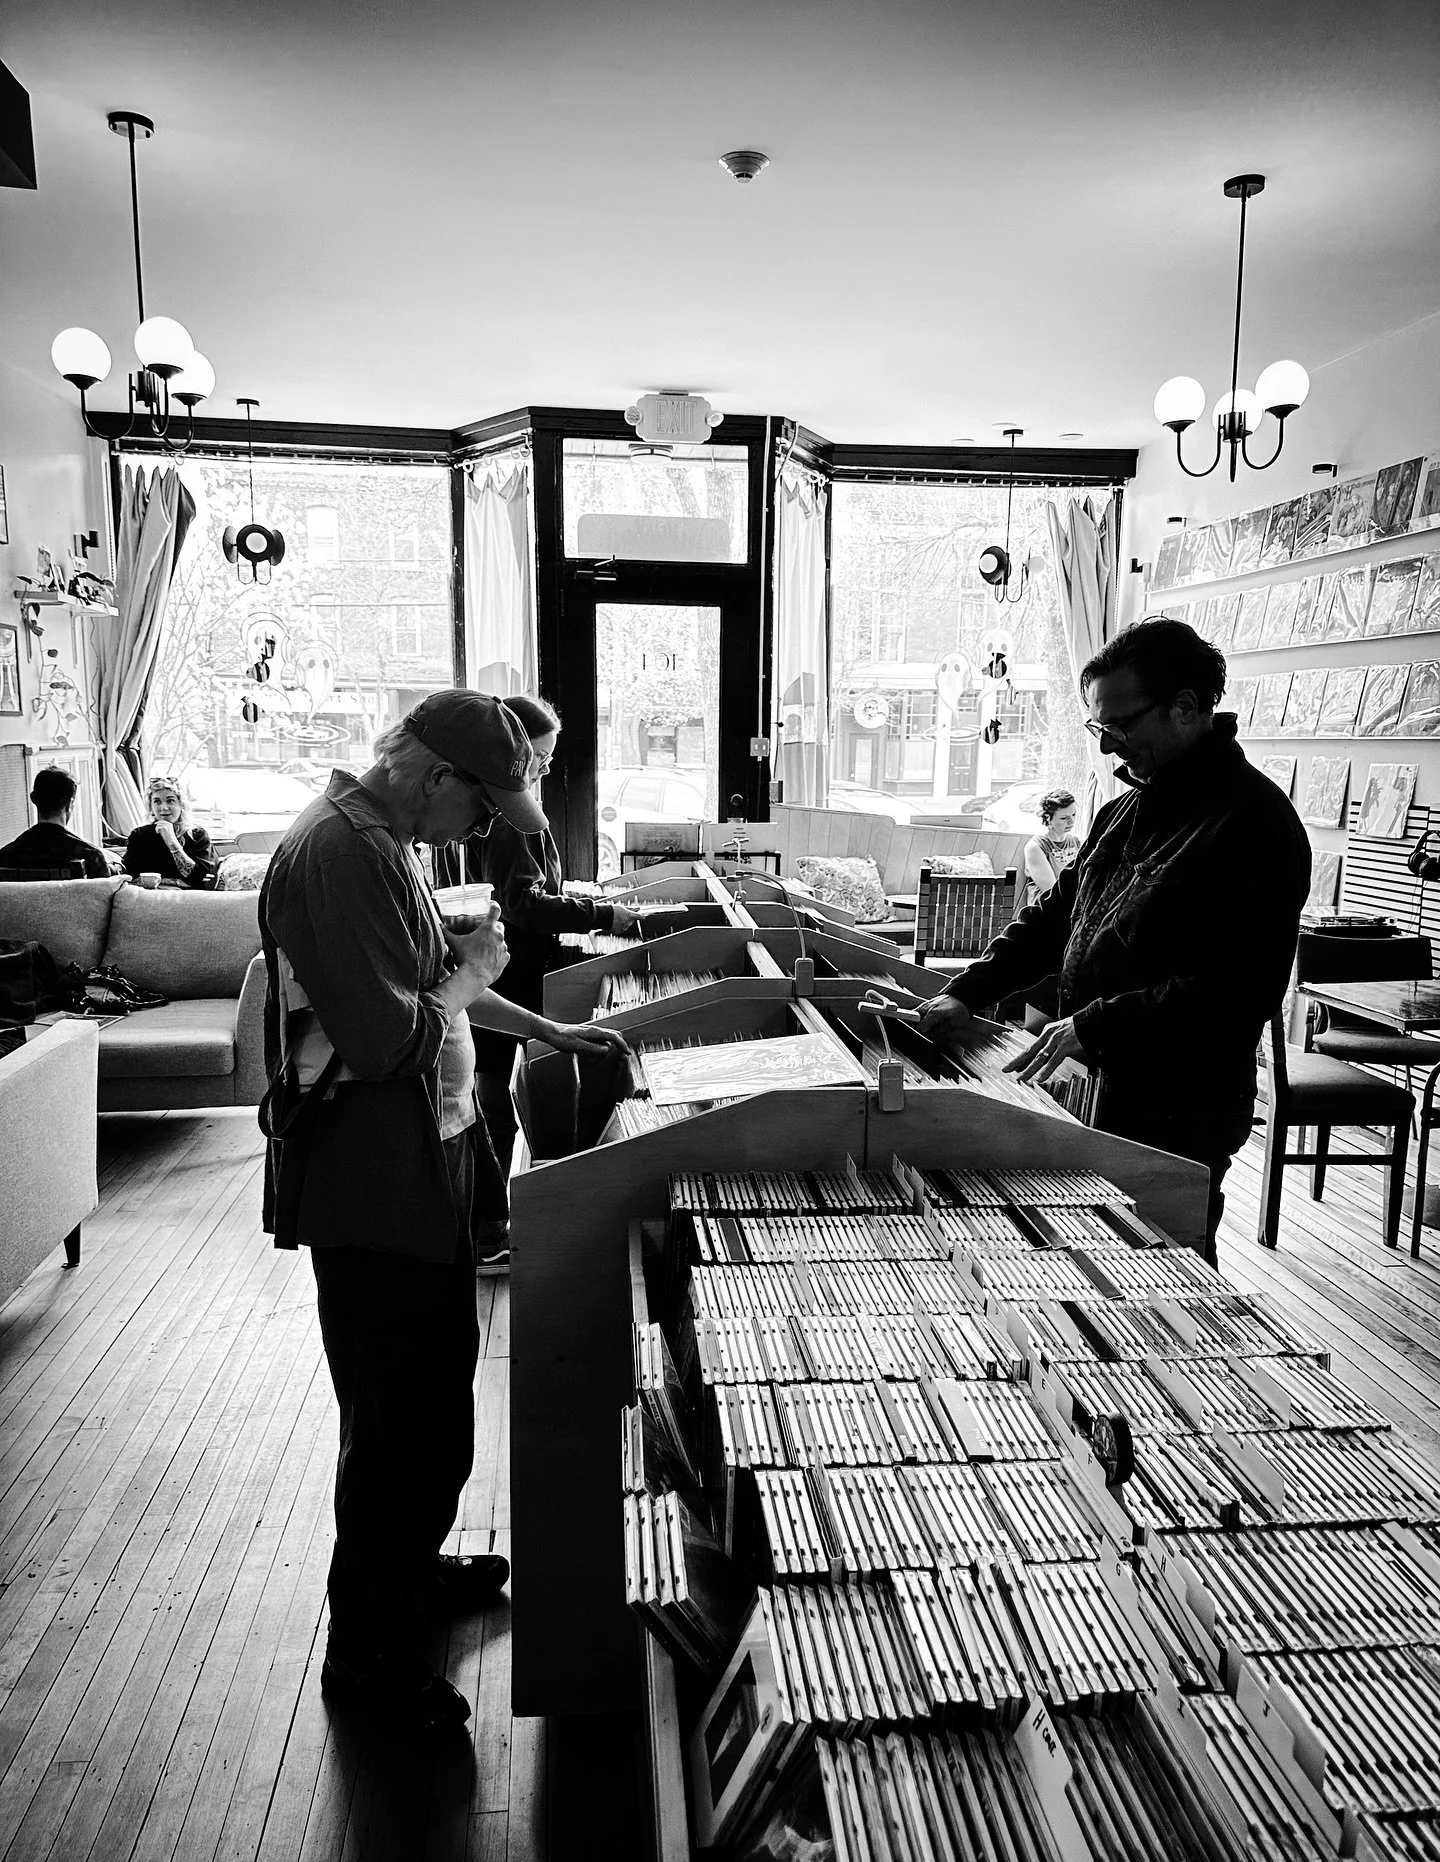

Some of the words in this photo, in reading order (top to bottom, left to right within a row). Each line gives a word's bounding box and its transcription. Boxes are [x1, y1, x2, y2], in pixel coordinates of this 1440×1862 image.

[655, 400, 697, 434] EXIT
[1041, 1378, 1046, 1390] E
[1115, 1563, 1121, 1576] G
[1160, 1554, 1167, 1573] H
[1032, 1708, 1046, 1731] H
